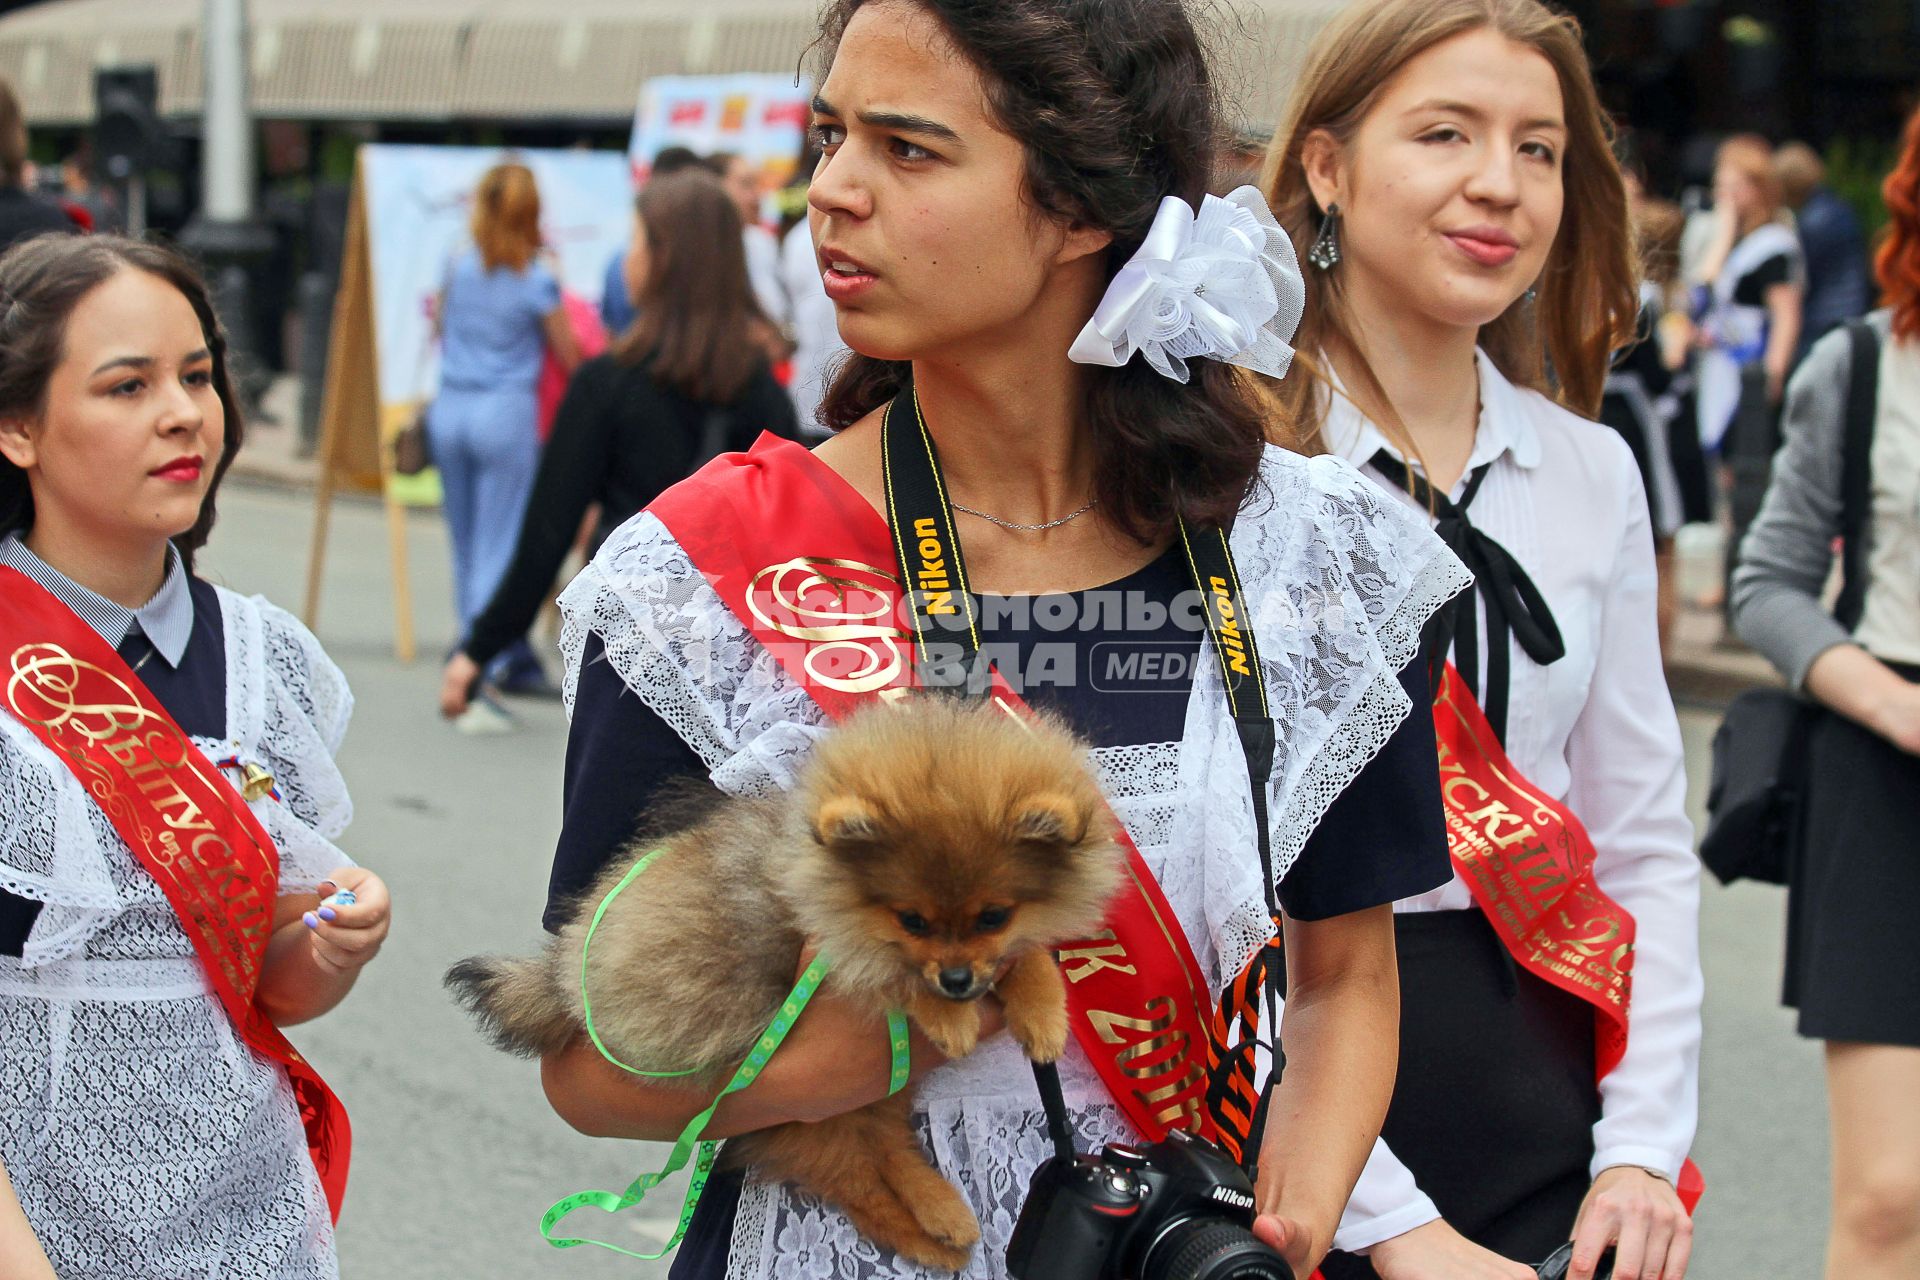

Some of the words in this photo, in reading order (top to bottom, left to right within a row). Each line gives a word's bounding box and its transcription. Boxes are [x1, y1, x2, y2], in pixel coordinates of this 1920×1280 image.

[911, 516, 956, 616] Nikon
[1209, 576, 1250, 676] Nikon
[1533, 929, 1559, 951] рог
[1561, 949, 1585, 966] на
[1212, 1186, 1254, 1208] Nikon
